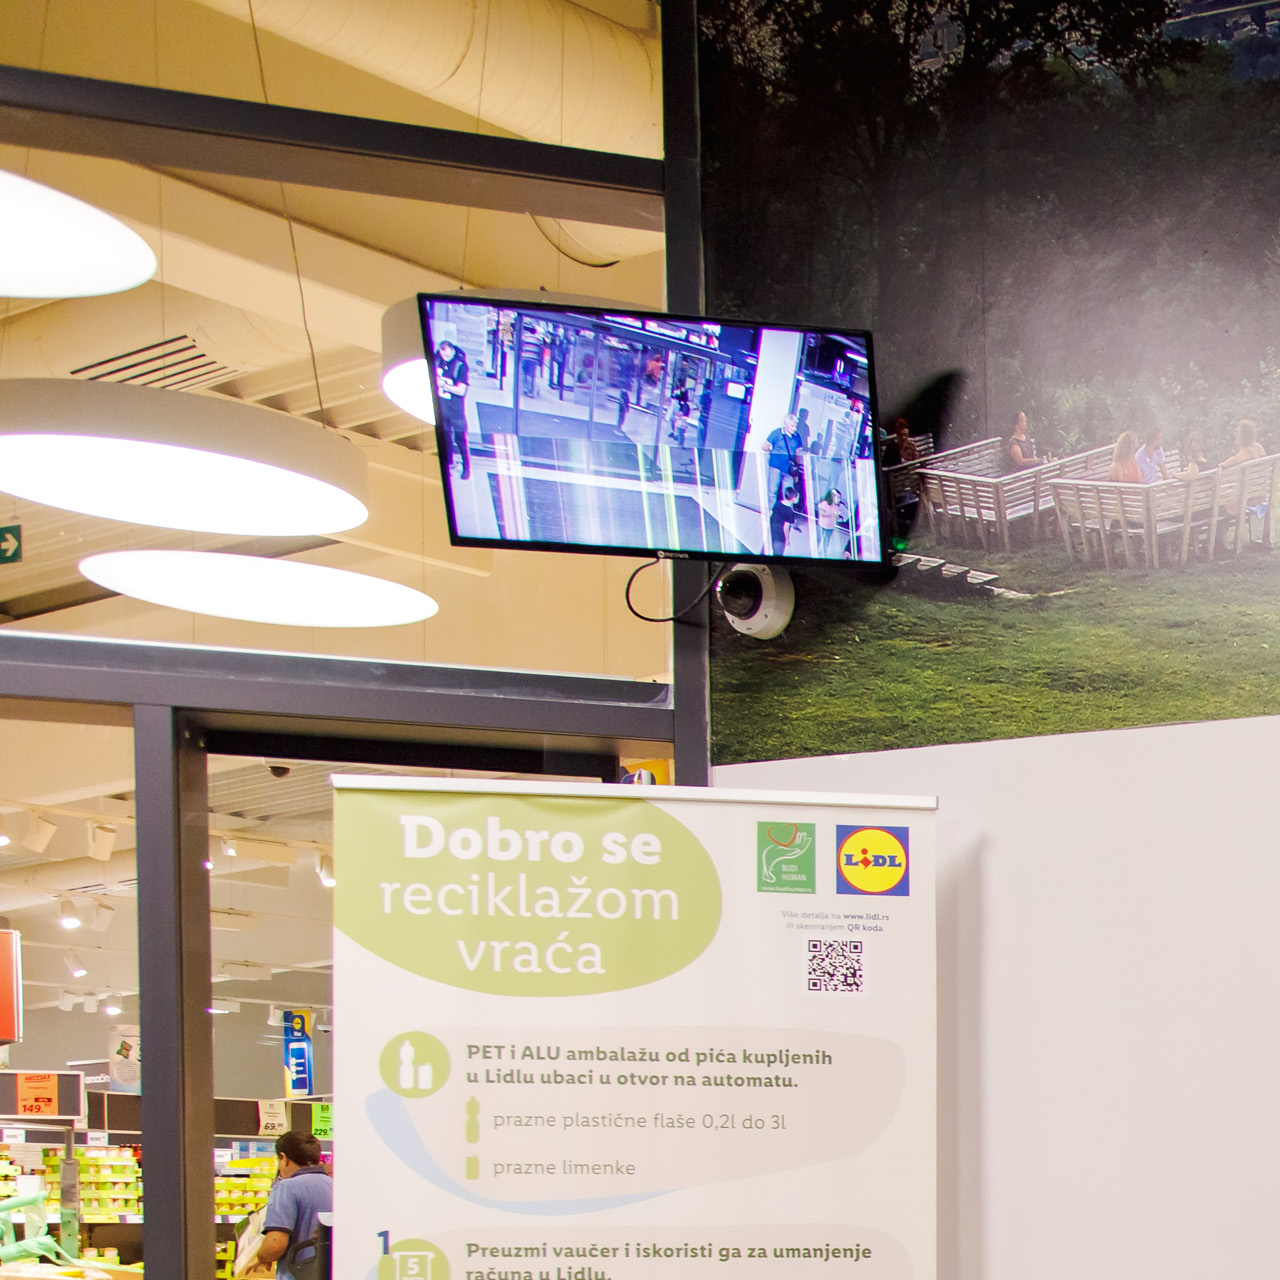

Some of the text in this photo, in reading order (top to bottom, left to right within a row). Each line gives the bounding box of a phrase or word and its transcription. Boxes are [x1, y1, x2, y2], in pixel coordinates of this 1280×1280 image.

[400, 814, 661, 865] Dobro se
[379, 874, 678, 920] reciklažom
[781, 910, 799, 918] Više
[801, 912, 829, 920] detalja
[843, 913, 890, 921] www.lidl.rs
[457, 932, 606, 974] vraća
[467, 1044, 832, 1068] PET i ALU ambalažu od pića kupljenih
[467, 1068, 798, 1088] u Lidlu ubaci u otvor na automatu.
[493, 1112, 786, 1131] prazne plastične flaše 0,2l do 3l
[493, 1159, 636, 1178] prazne limenke
[377, 1230, 390, 1255] 1
[466, 1242, 872, 1263] Preuzmi vaučer i iskoristi ga za umanjenje
[407, 1258, 420, 1275] 5
